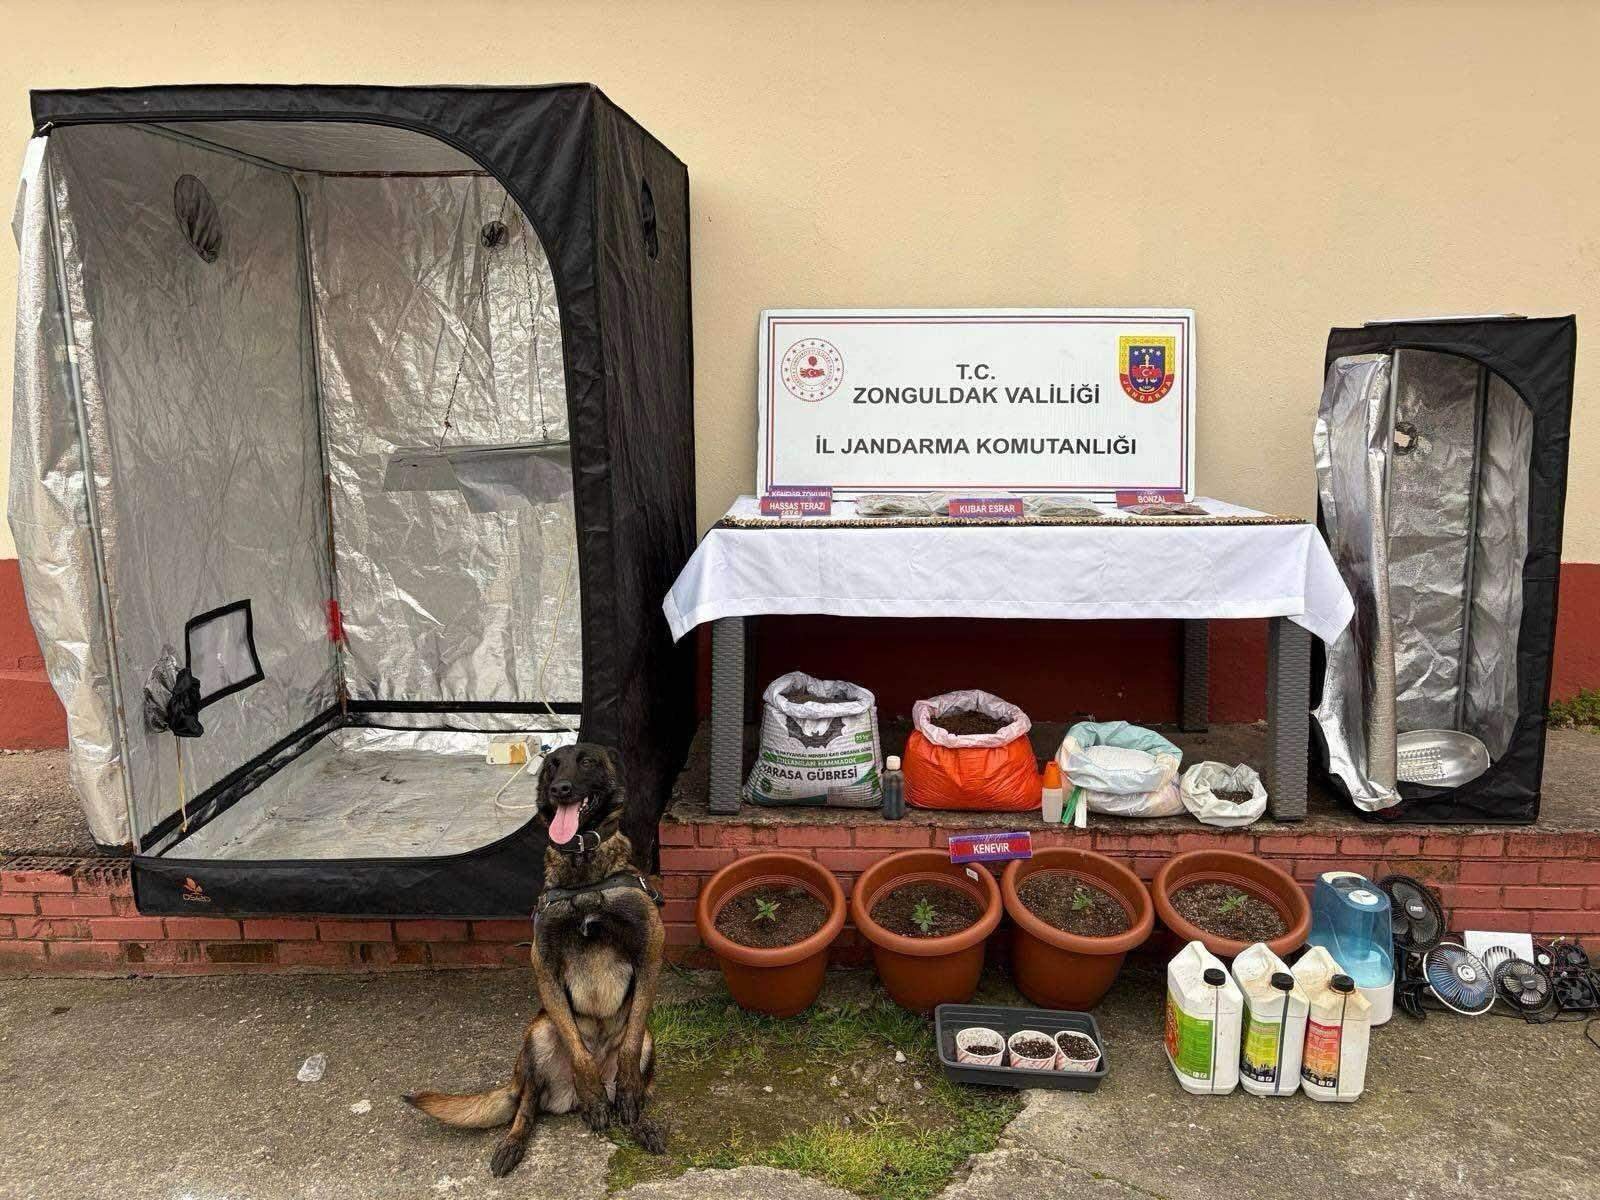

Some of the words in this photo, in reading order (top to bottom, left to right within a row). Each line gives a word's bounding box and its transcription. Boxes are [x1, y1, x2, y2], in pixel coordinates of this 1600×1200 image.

[956, 364, 996, 380] T.C.
[853, 387, 998, 404] ZONGULDAK
[1005, 383, 1100, 404] VALİLİĞİ
[1122, 380, 1172, 402] JANDARMA
[816, 434, 835, 454] İL
[841, 438, 970, 454] JANDARMA
[976, 435, 1136, 455] KOMUTANLIĞI
[769, 502, 798, 511] HASSAS
[960, 505, 987, 514] KUBAR
[989, 504, 1016, 513] ESRAR
[807, 766, 858, 781] GÜBRESİ
